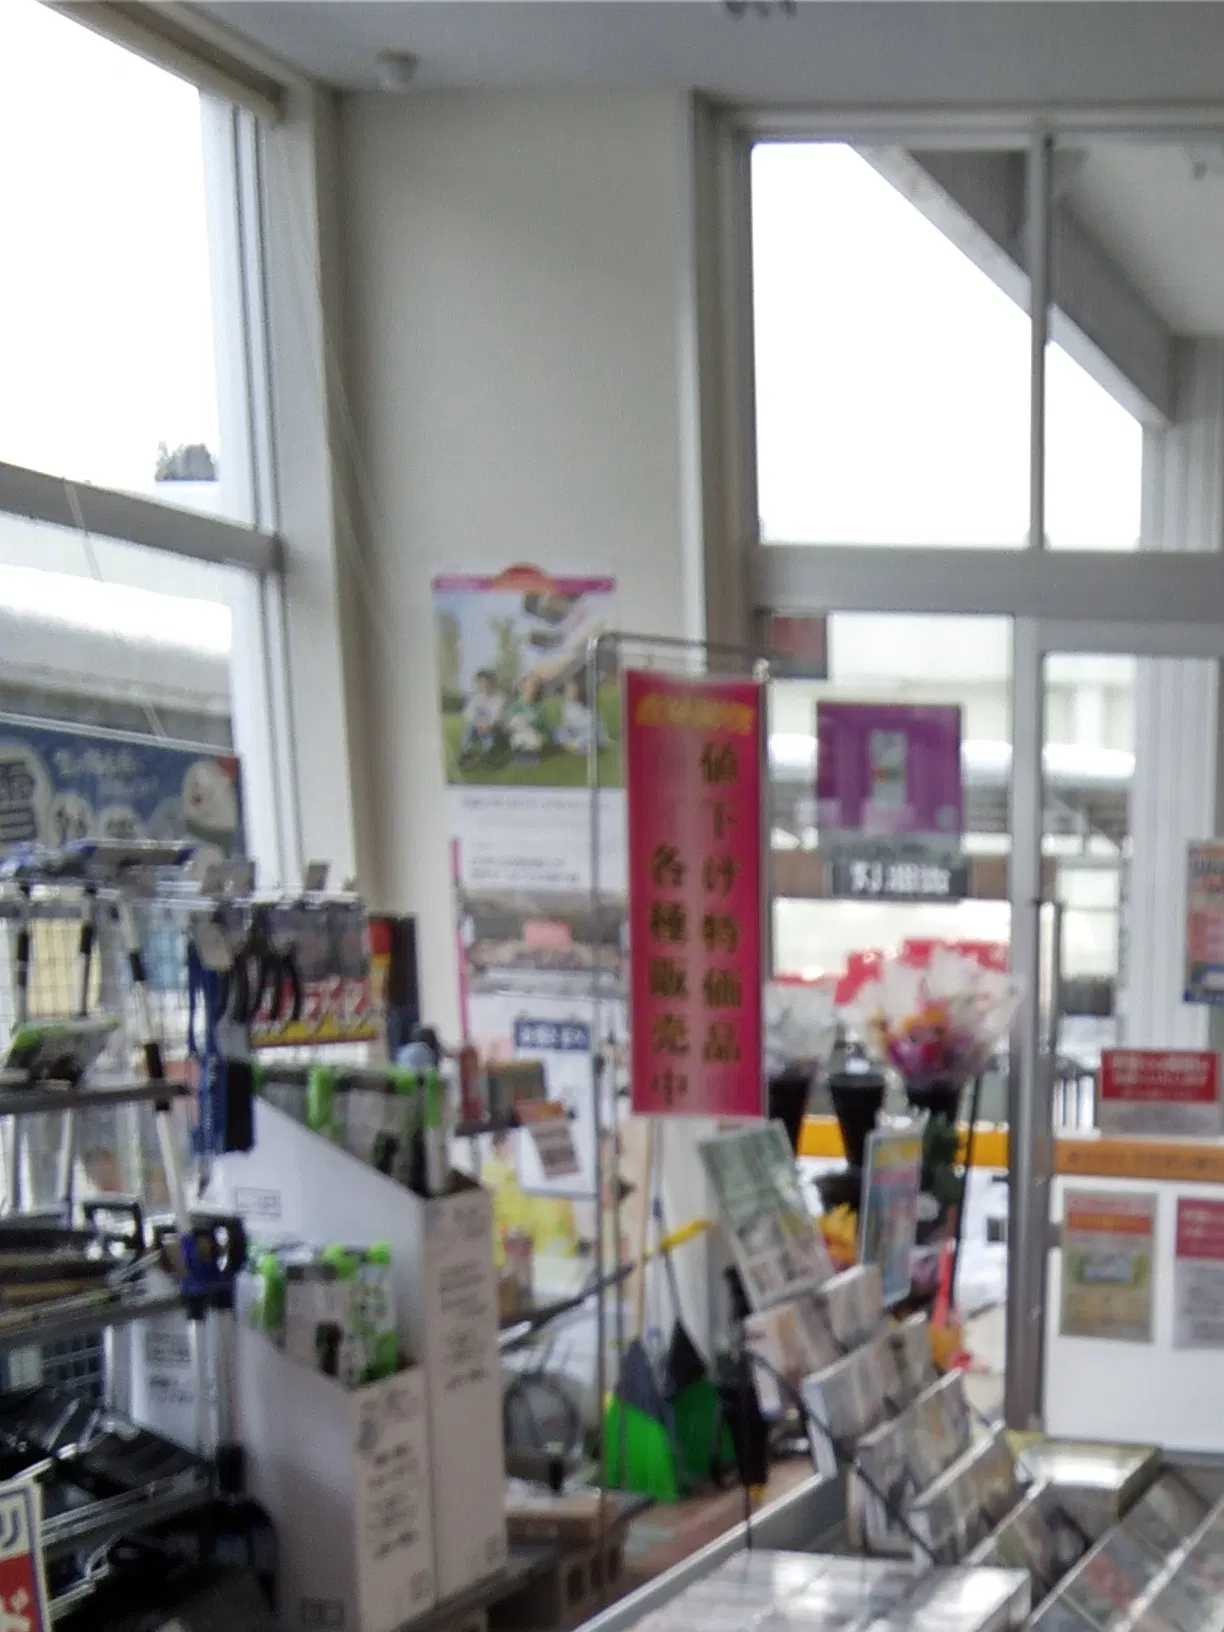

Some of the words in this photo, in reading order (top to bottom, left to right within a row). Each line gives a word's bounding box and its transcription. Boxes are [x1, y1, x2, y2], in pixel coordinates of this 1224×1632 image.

[649, 843, 691, 1107] 各種販売中
